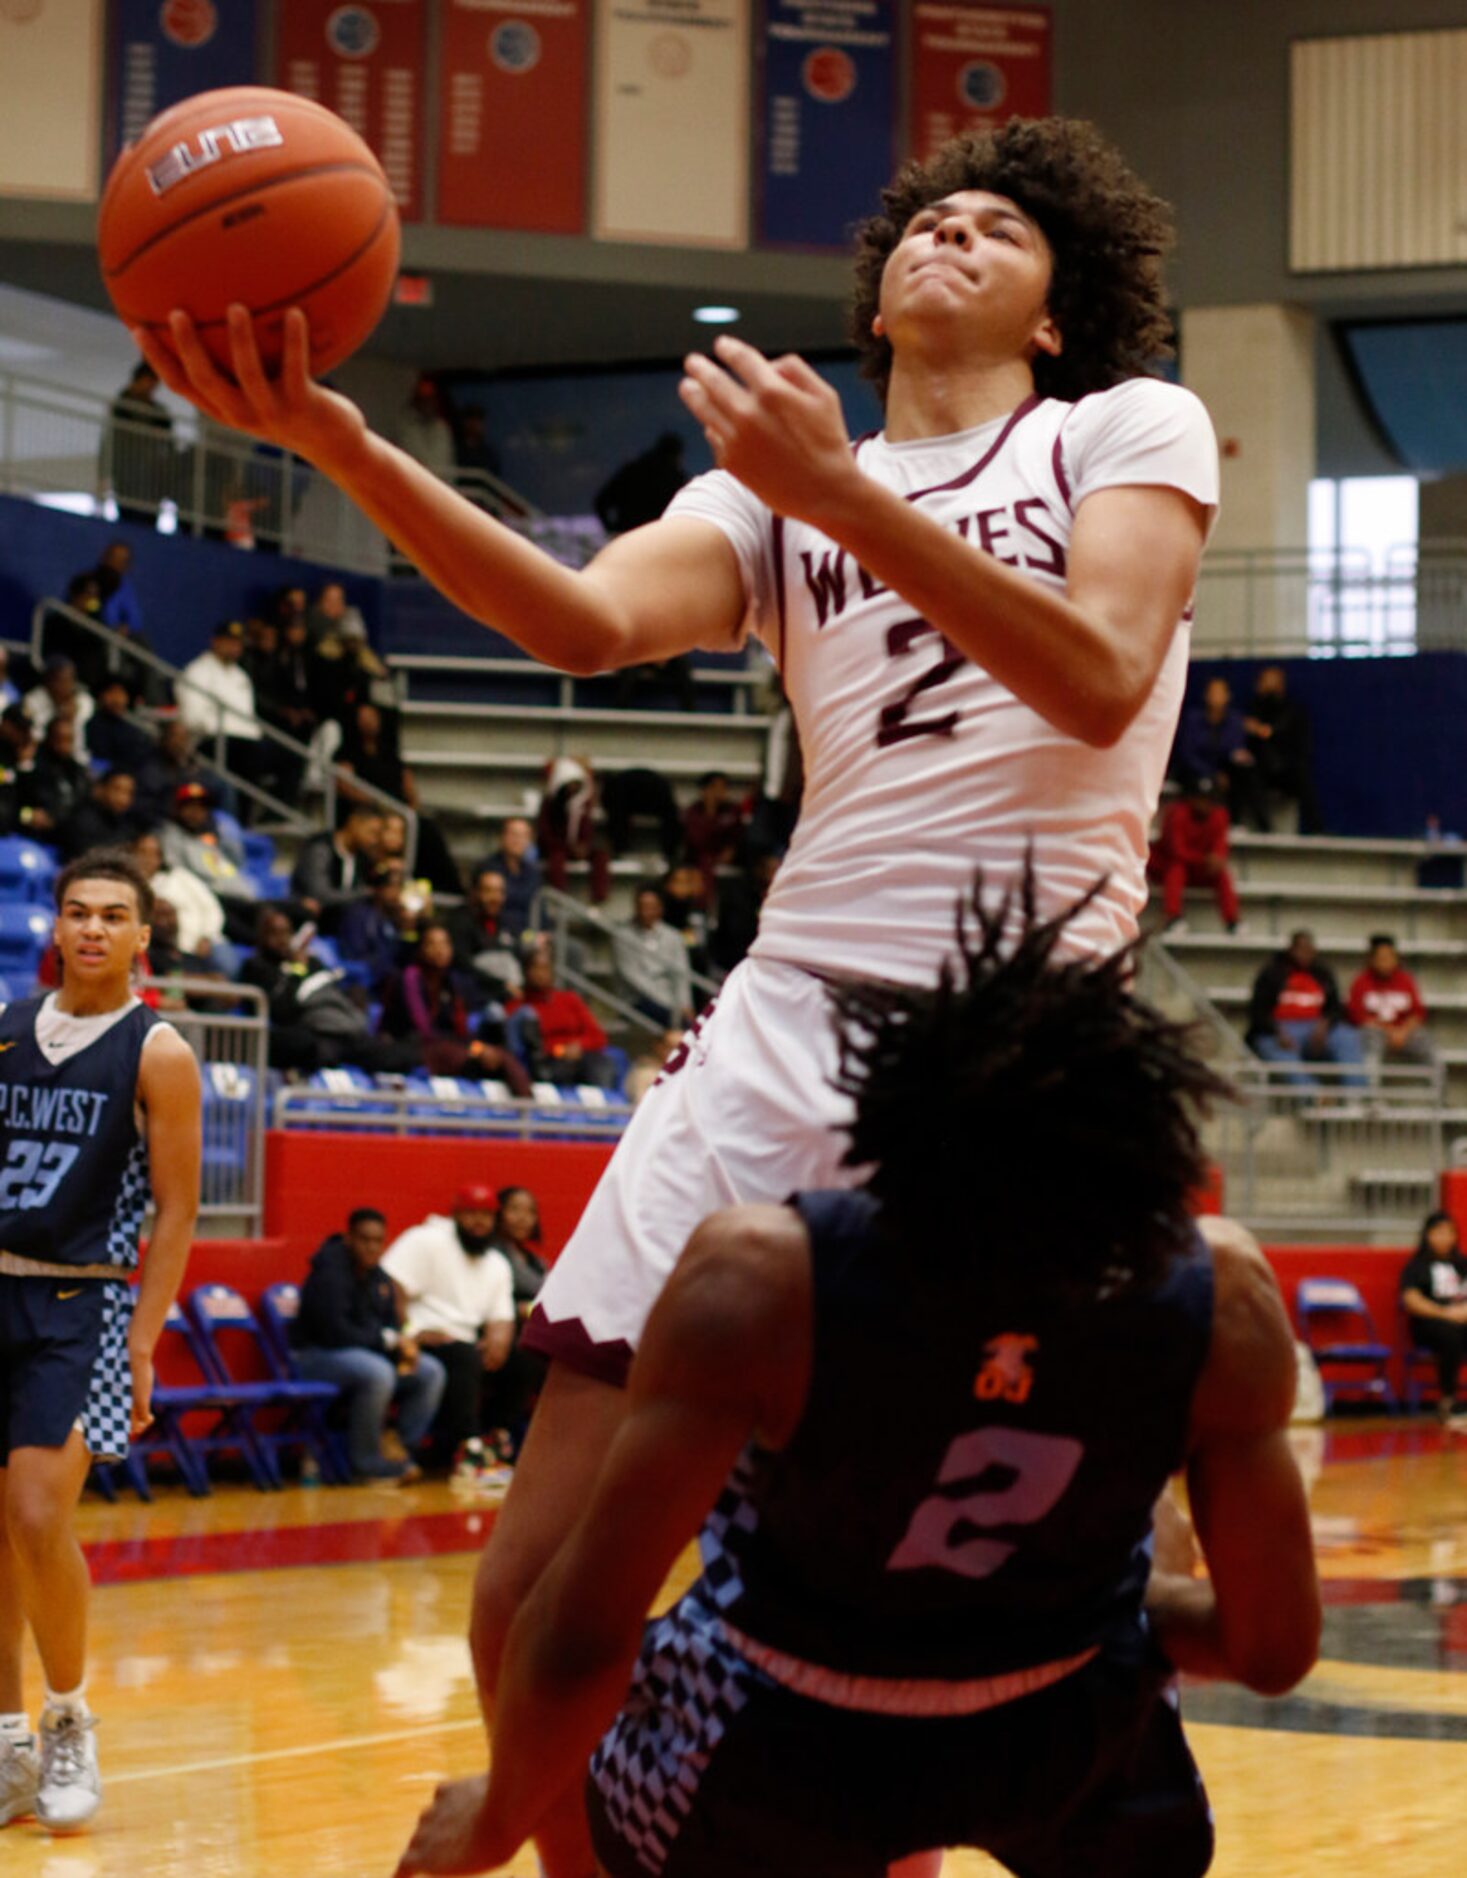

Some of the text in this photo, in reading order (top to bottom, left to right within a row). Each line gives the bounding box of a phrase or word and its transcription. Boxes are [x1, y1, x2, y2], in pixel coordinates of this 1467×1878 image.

[876, 616, 968, 748] 2
[0, 1140, 80, 1210] 23
[885, 1425, 1085, 1570] 2
